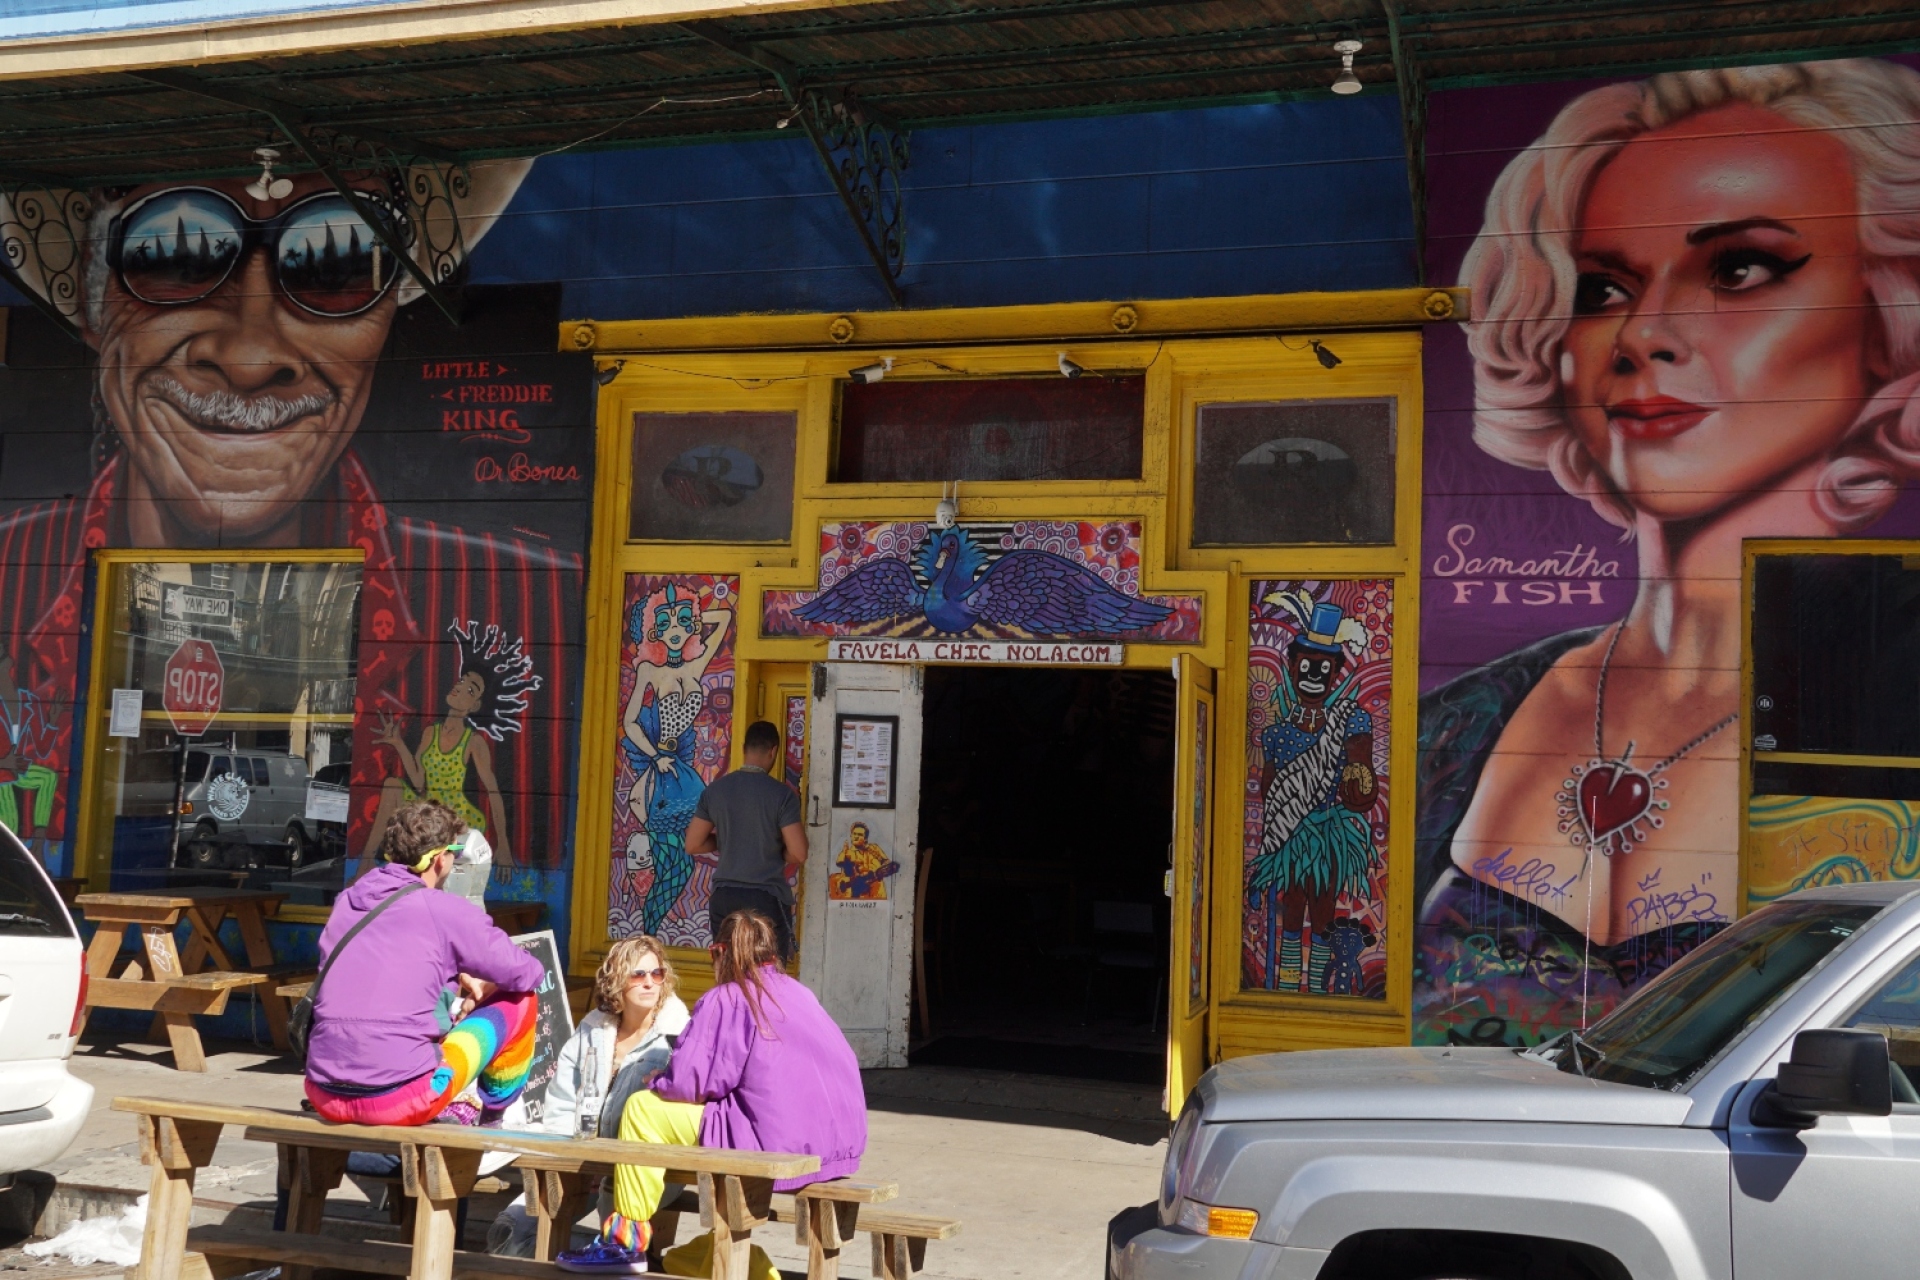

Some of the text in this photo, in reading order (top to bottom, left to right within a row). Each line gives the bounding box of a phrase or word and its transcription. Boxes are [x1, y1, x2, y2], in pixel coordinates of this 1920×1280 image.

[422, 361, 490, 380] LITTLE
[459, 384, 553, 403] FREDDIE
[442, 409, 522, 432] KING
[507, 452, 582, 483] Bones
[1433, 523, 1620, 578] Samantha
[1452, 580, 1605, 606] FISH
[838, 642, 921, 660] FAVELA
[934, 643, 992, 660] CHIC
